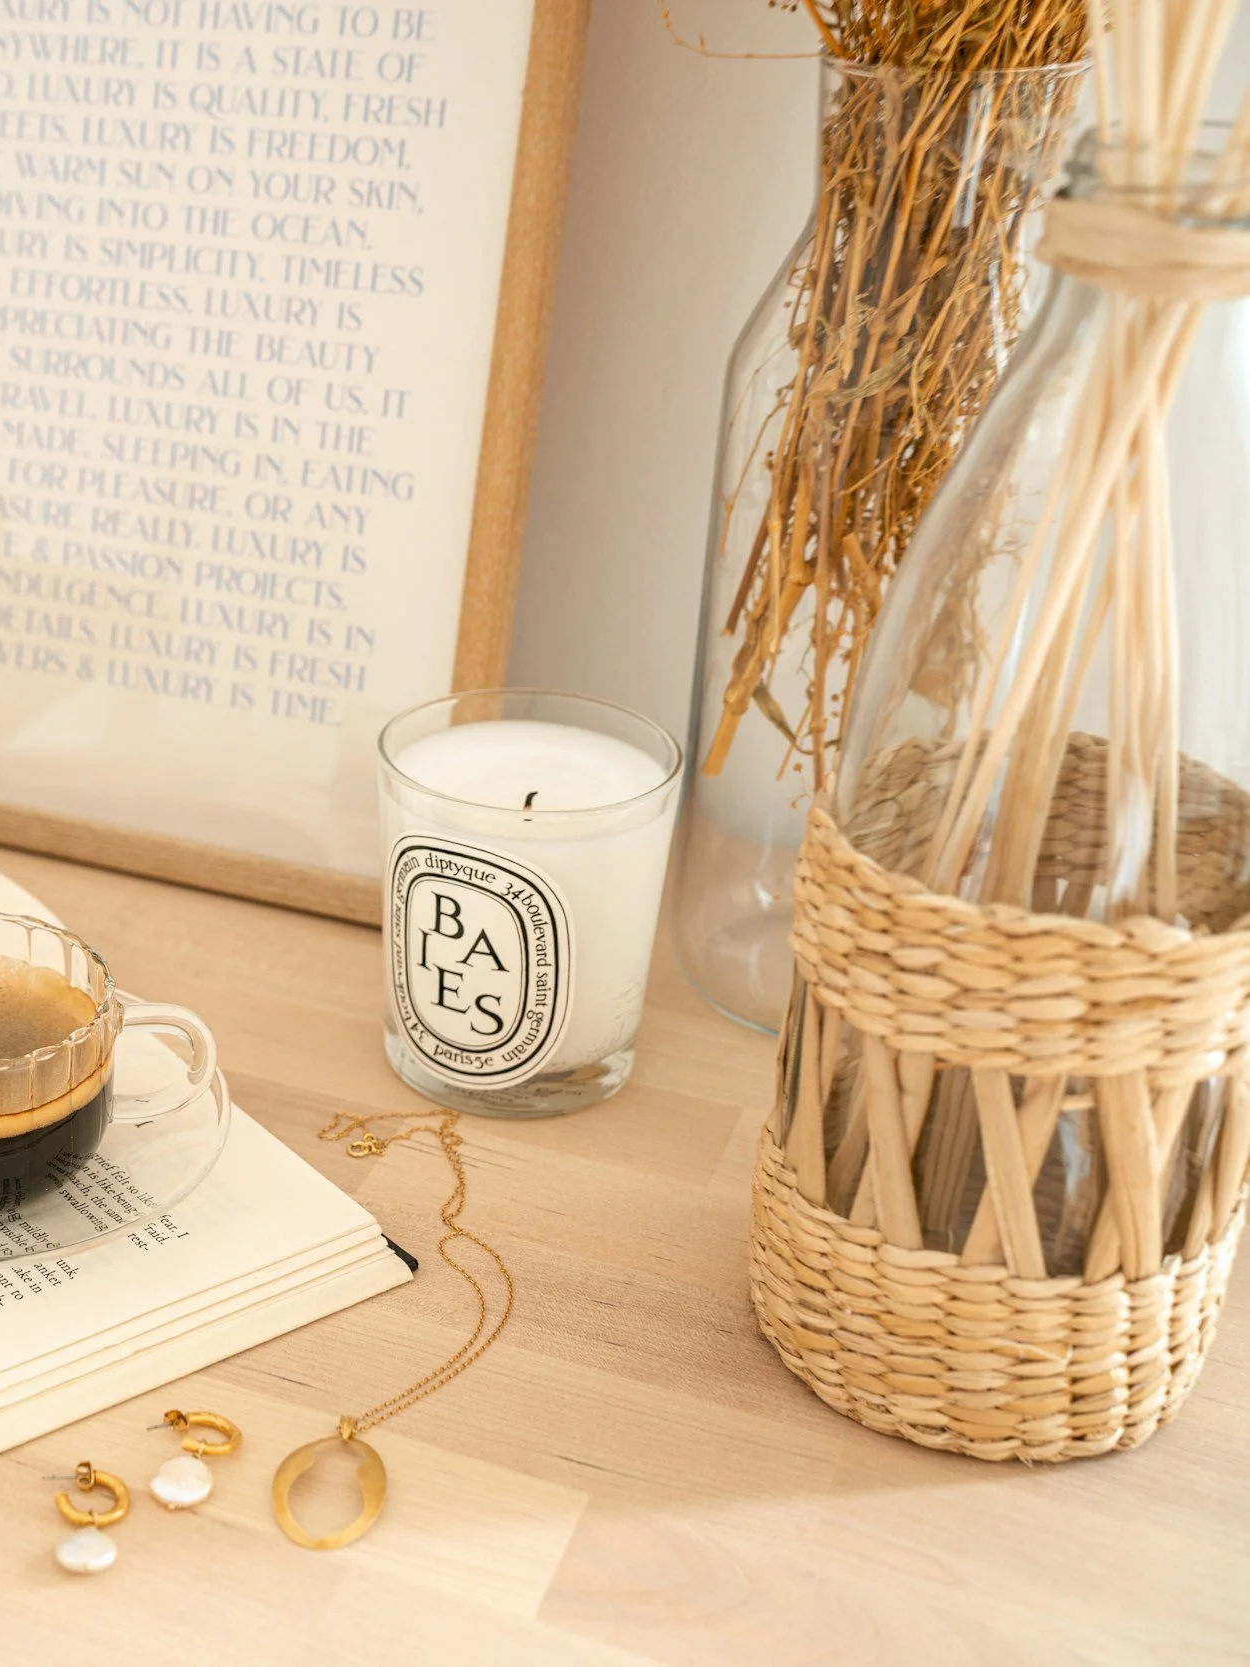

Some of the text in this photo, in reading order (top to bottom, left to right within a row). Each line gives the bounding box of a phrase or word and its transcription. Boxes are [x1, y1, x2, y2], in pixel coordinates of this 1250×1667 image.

[87, 1, 112, 21] IS
[123, 0, 180, 24] NOT
[200, 1, 320, 32] HAVING
[340, 8, 380, 35] TO
[393, 10, 434, 39] BE
[155, 40, 185, 68] IT
[196, 44, 225, 69] IS
[235, 46, 258, 72] A
[272, 47, 363, 78] STATE
[376, 53, 425, 81] OF
[26, 74, 138, 106] LUXURY
[153, 82, 180, 108] IS
[341, 93, 446, 126] FRESH
[82, 118, 196, 150] LUXURY
[209, 126, 238, 153] IS
[15, 152, 106, 183] WARM
[119, 161, 175, 189] SUN
[187, 166, 235, 193] ON
[249, 171, 336, 203] YOUR
[97, 198, 170, 229] INTO
[185, 206, 238, 235] THE
[65, 236, 89, 261] IS
[283, 256, 425, 294] TIMELESS
[205, 289, 322, 325] LUXURY
[338, 303, 363, 329] IS
[189, 327, 238, 357] THE
[257, 335, 378, 372] BEAUTY
[9, 345, 187, 389] SURROUNDS
[199, 368, 252, 398] ALL
[267, 376, 310, 405] OF
[382, 389, 410, 418] IT
[109, 396, 220, 433] LUXURY
[235, 413, 260, 438] IS
[272, 417, 301, 443] IN
[318, 422, 374, 454] THE
[102, 433, 242, 475] SLEEPING
[302, 460, 415, 499] EATING
[9, 458, 68, 489] FOR
[244, 492, 293, 522] OR
[306, 501, 369, 533] ANY
[32, 537, 50, 562] &
[63, 542, 183, 582] PASSION
[212, 526, 328, 567] LUXURY
[342, 546, 368, 572] IS
[180, 598, 294, 640] LUXURY
[307, 619, 333, 646] IS
[346, 625, 376, 653] IN
[77, 656, 96, 681] &
[105, 659, 216, 702] LUXURY
[231, 684, 255, 708] IS
[110, 623, 219, 665] LUXURY
[234, 645, 259, 672] IS
[270, 651, 366, 691] FRESH
[425, 853, 496, 884] diptyque
[500, 882, 551, 1062] 34 boulevard saint germain
